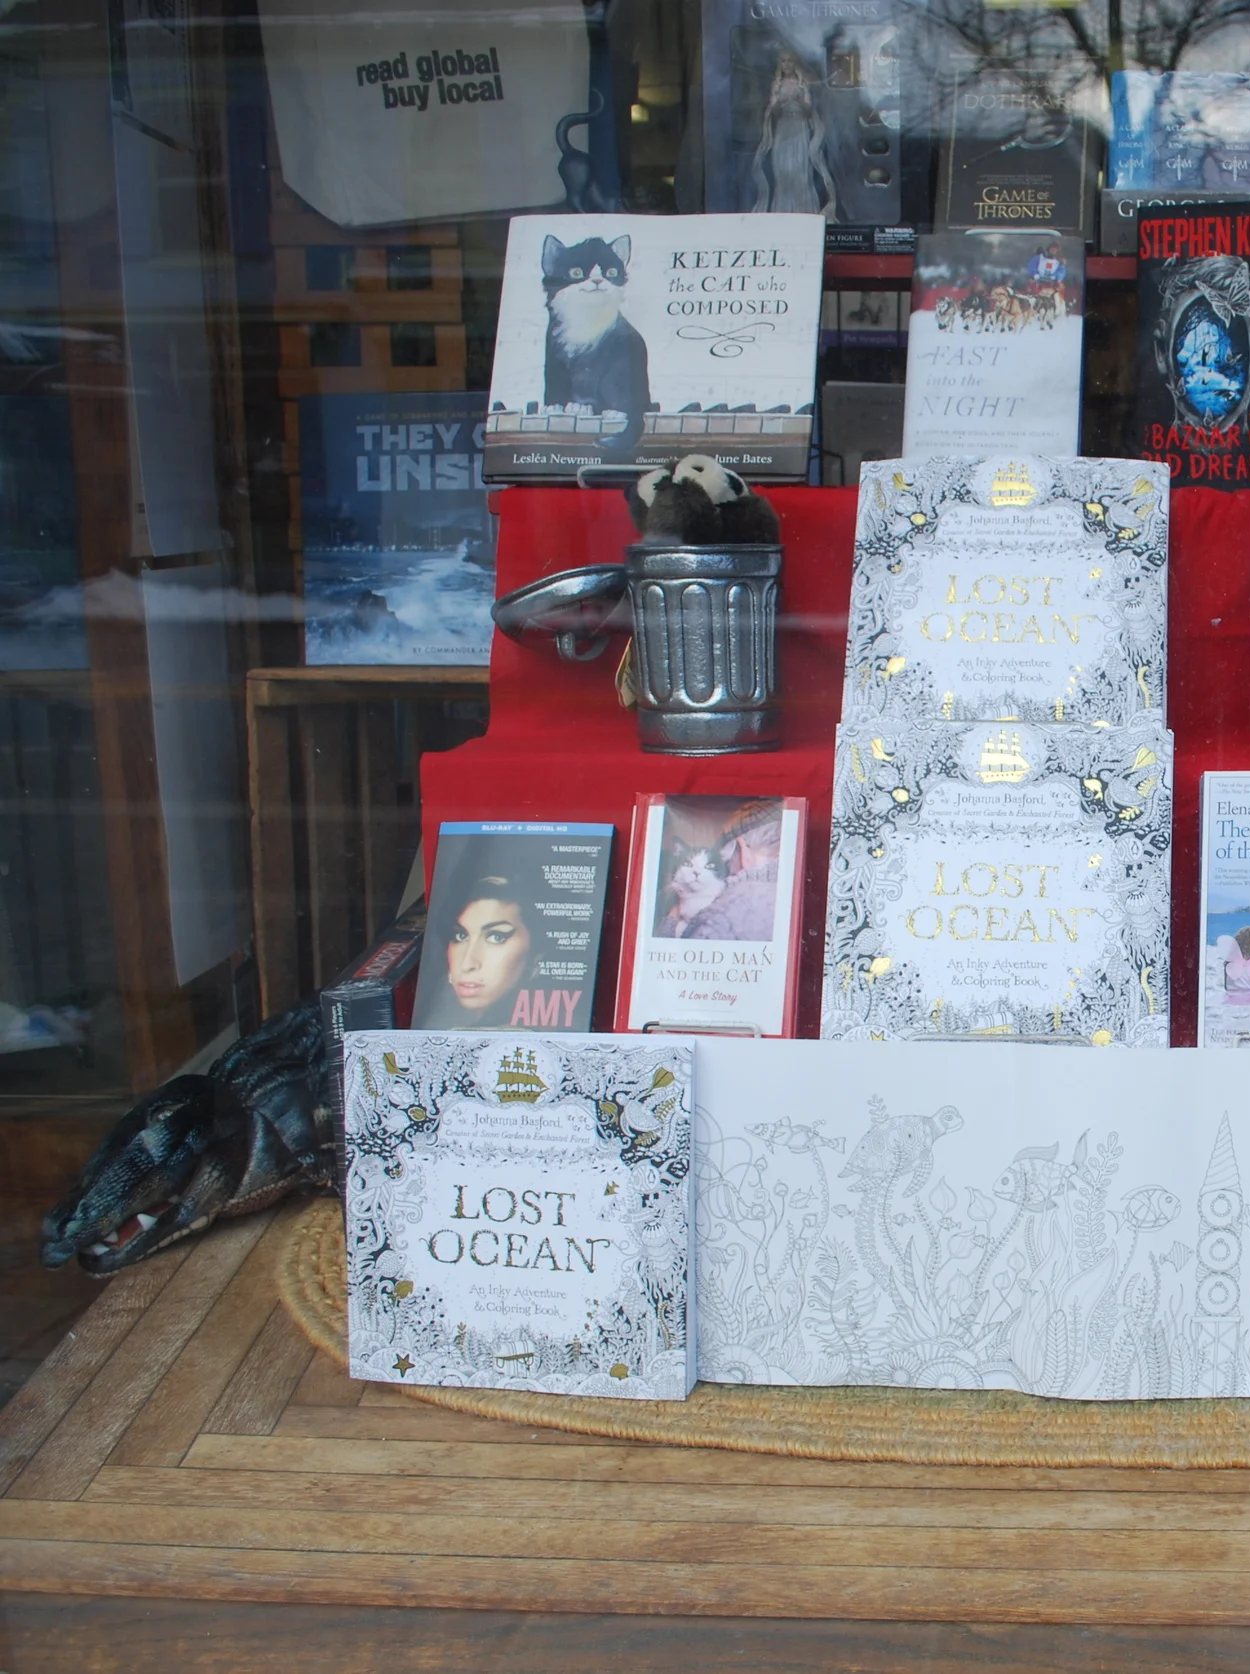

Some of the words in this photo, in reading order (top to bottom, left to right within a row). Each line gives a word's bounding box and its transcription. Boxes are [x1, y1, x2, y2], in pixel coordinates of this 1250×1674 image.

[356, 52, 409, 86] read
[416, 47, 500, 82] global
[382, 83, 429, 111] buy
[437, 75, 504, 104] local
[982, 186, 1035, 204] GAME
[974, 202, 1055, 220] THRONES
[1140, 216, 1231, 259] STEPHEN
[669, 277, 695, 292] the
[701, 276, 751, 292] CAT
[757, 276, 787, 291] who
[667, 300, 789, 315] COMPOSED
[916, 345, 1008, 366] FAST
[926, 374, 956, 386] into
[960, 374, 984, 386] the
[917, 396, 1024, 417] NIGHT
[356, 423, 462, 451] THEY
[1152, 424, 1241, 450] BAZAAR
[513, 453, 547, 465] Lesléa
[550, 454, 602, 465] Newman
[743, 454, 772, 464] Bates
[943, 573, 1063, 606] LOST
[917, 611, 1098, 645] OCEAN
[1216, 820, 1250, 838] The
[1215, 841, 1235, 859] of
[929, 861, 1059, 899] LOST
[904, 905, 1098, 943] OCEAN
[647, 951, 677, 963] THE
[683, 950, 724, 964] OLD
[732, 949, 774, 965] MAN
[991, 958, 1048, 970] Adventure
[657, 970, 688, 980] AND
[692, 970, 720, 981] THE
[726, 968, 763, 982] CAT
[963, 975, 1011, 990] Coloring
[1014, 975, 1048, 990] Book
[688, 990, 708, 1001] Love
[711, 990, 738, 1006] Story
[510, 990, 582, 1026] AMY
[472, 1113, 518, 1128] Johanna
[450, 1184, 576, 1227] LOST
[420, 1229, 611, 1274] OCEAN
[514, 1285, 567, 1299] Adventure
[486, 1301, 531, 1316] Coloring
[534, 1305, 567, 1320] Book
